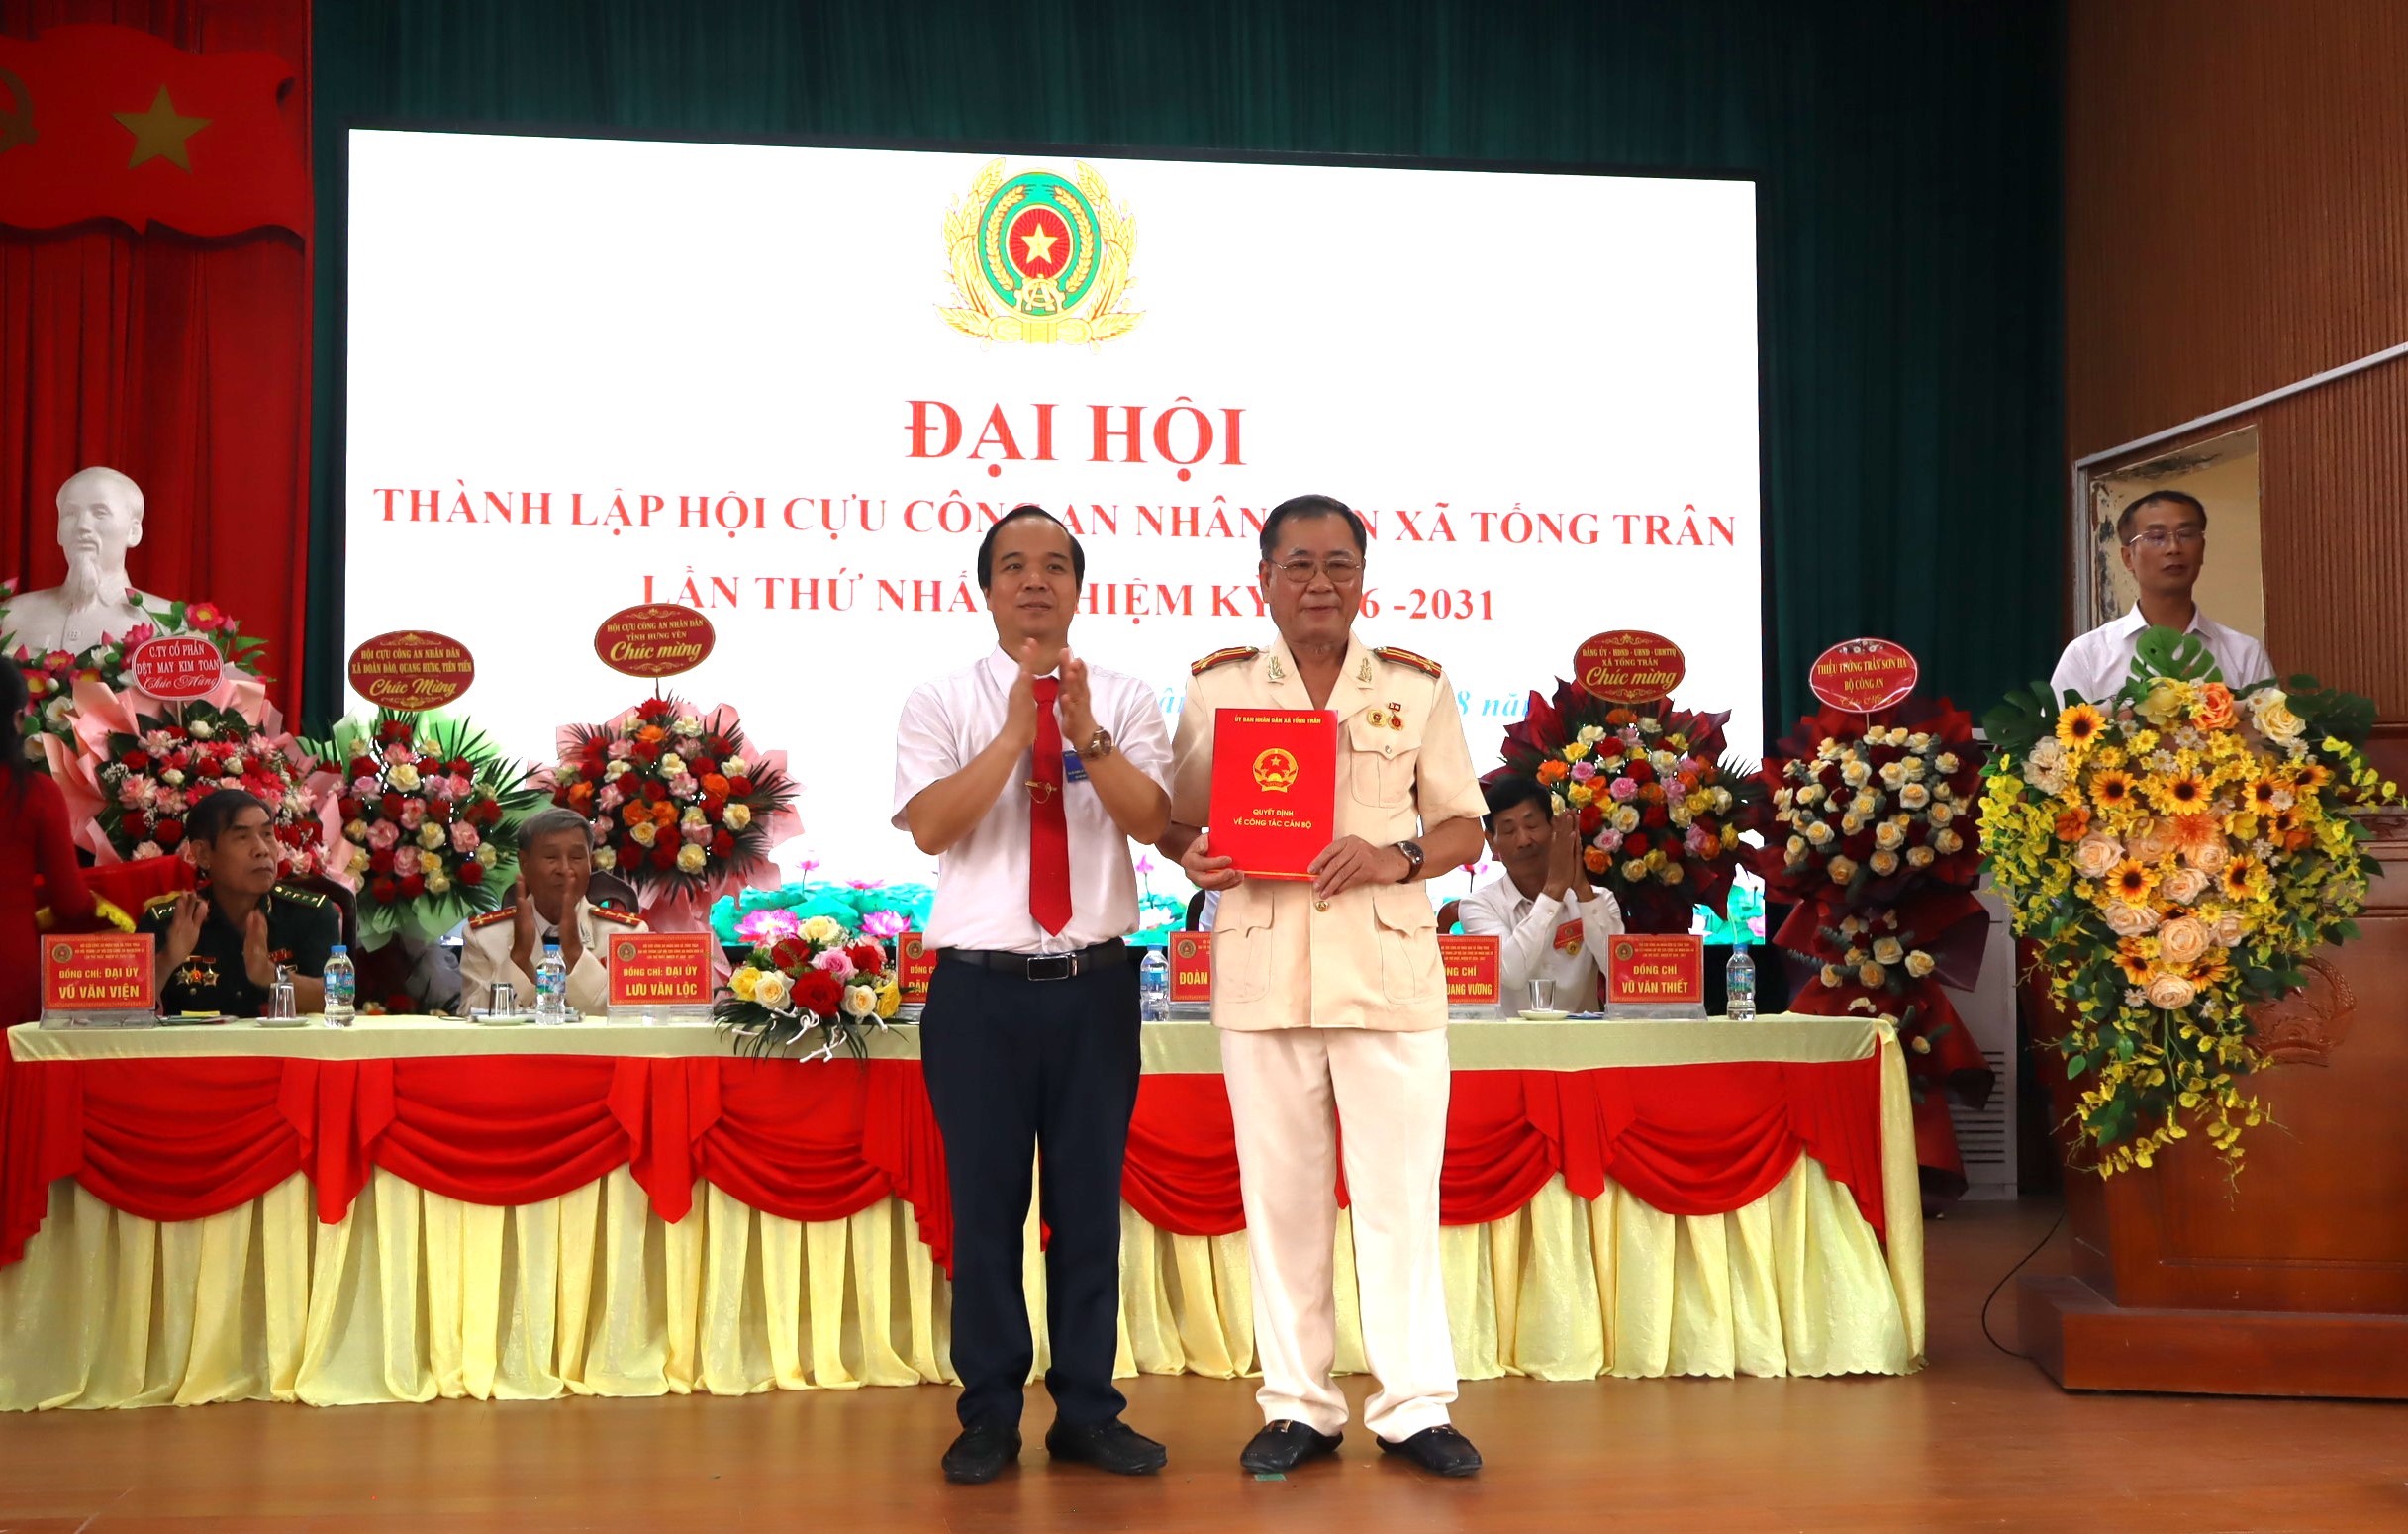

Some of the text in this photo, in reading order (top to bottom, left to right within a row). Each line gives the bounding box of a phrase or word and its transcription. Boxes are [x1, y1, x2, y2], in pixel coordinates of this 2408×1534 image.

[904, 396, 1247, 482] ĐẠI HỘI
[373, 478, 552, 525] THÀNH
[570, 488, 664, 535] LẬP
[678, 490, 767, 538] HỘI
[783, 493, 887, 540] CỰU
[903, 489, 1039, 533] CÔN
[1061, 503, 1119, 536] AN
[1135, 494, 1267, 538] NHÂN
[1395, 501, 1458, 542] XÃ
[1470, 502, 1599, 545] TỐNG
[1612, 503, 1735, 546] TRÂN
[643, 565, 739, 609] LẦN
[754, 567, 864, 612] THỨ
[876, 570, 978, 613] NHẤ
[1074, 577, 1194, 625] HIỆM
[413, 650, 423, 659] AN
[610, 641, 703, 662] Chúc mừng
[136, 659, 152, 675] DỆT
[157, 661, 175, 674] MAY
[178, 660, 194, 673] KIM
[1586, 666, 1678, 690] Chúc mừng
[1844, 676, 1884, 693] BỘ CÔNG AN
[369, 677, 457, 697] Chúc Mừng
[104, 967, 123, 980] ĐẠI
[665, 966, 682, 979] ĐẠI
[1179, 968, 1208, 985] ĐOÀN
[1461, 964, 1477, 977] CHÍ
[1661, 963, 1678, 975] CHÍ
[58, 982, 140, 1001] VŨ VĂN VIỆN
[626, 980, 698, 998] LƯU VĂN LỘC
[1621, 978, 1688, 993] VŨ VĂN THIẾT
